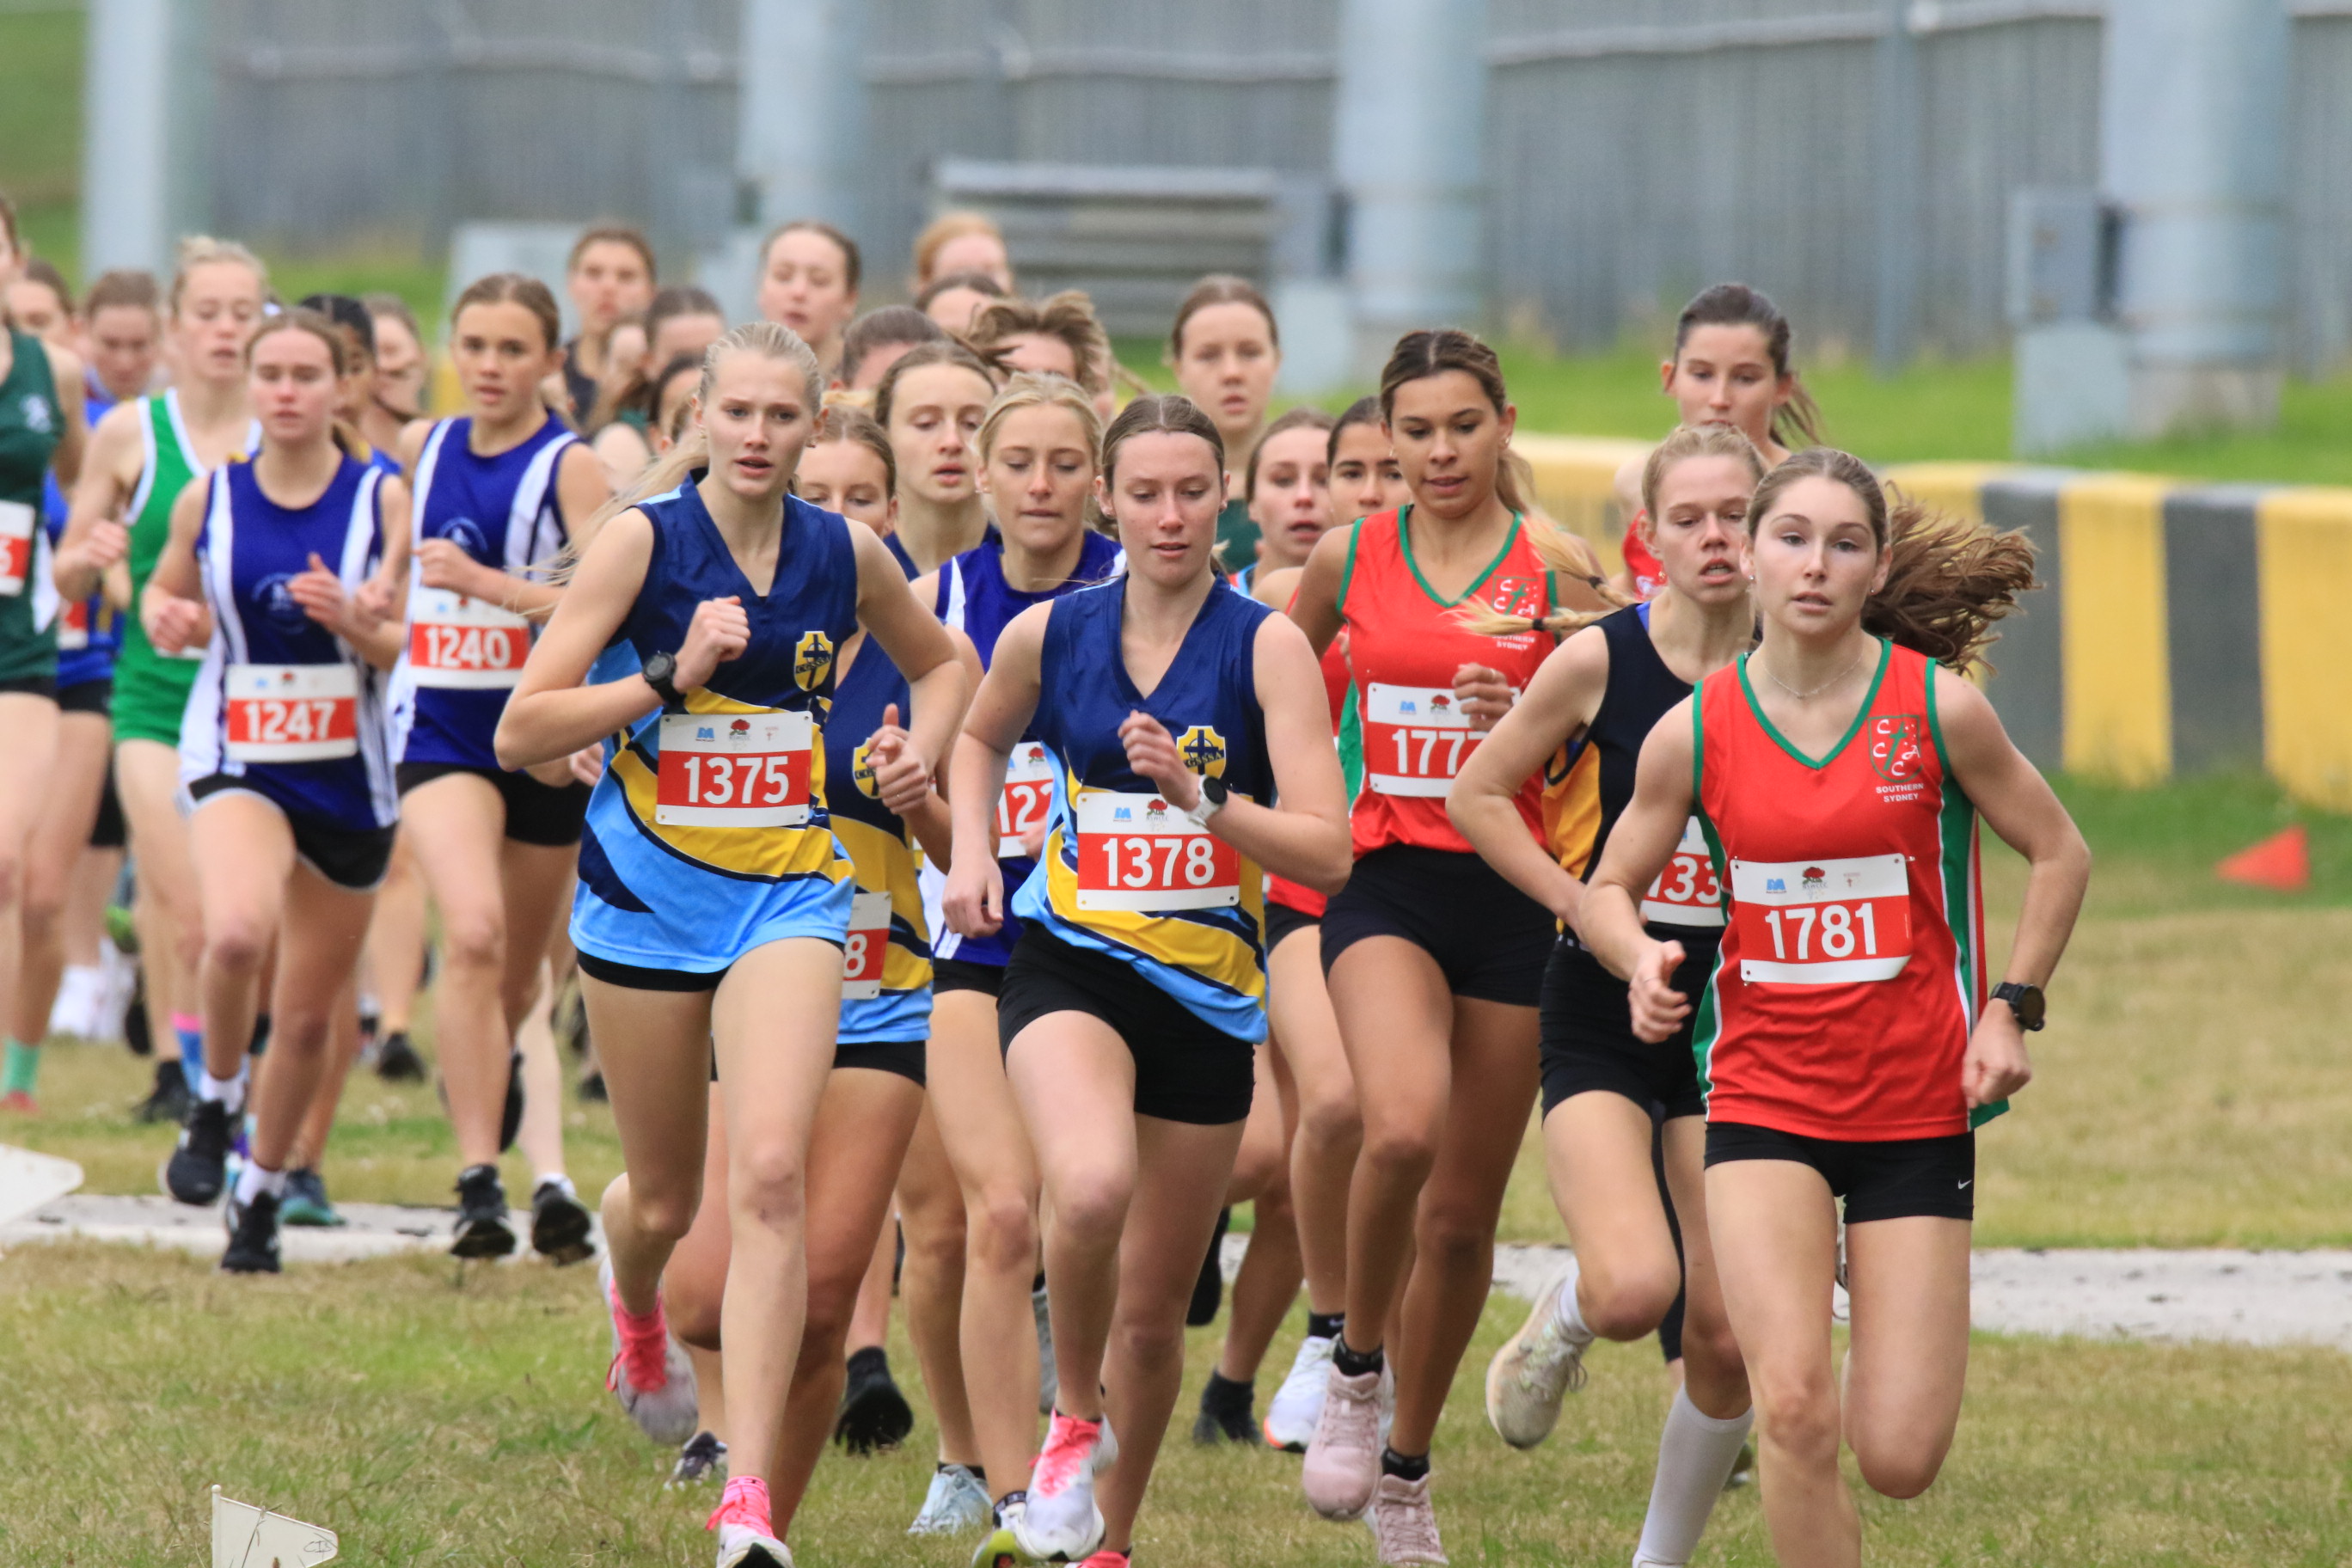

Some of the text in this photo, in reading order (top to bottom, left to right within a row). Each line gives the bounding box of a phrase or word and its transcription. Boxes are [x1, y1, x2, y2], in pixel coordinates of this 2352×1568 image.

[426, 627, 511, 668] 1240
[244, 701, 336, 742] 1247
[1185, 751, 1222, 766] GSSSA
[684, 756, 789, 805] 1375
[1876, 783, 1924, 793] SOUTHERN
[1883, 793, 1919, 803] SYDNEY
[997, 782, 1054, 833] 12
[1102, 837, 1215, 888] 1378
[1765, 903, 1877, 959] 1781
